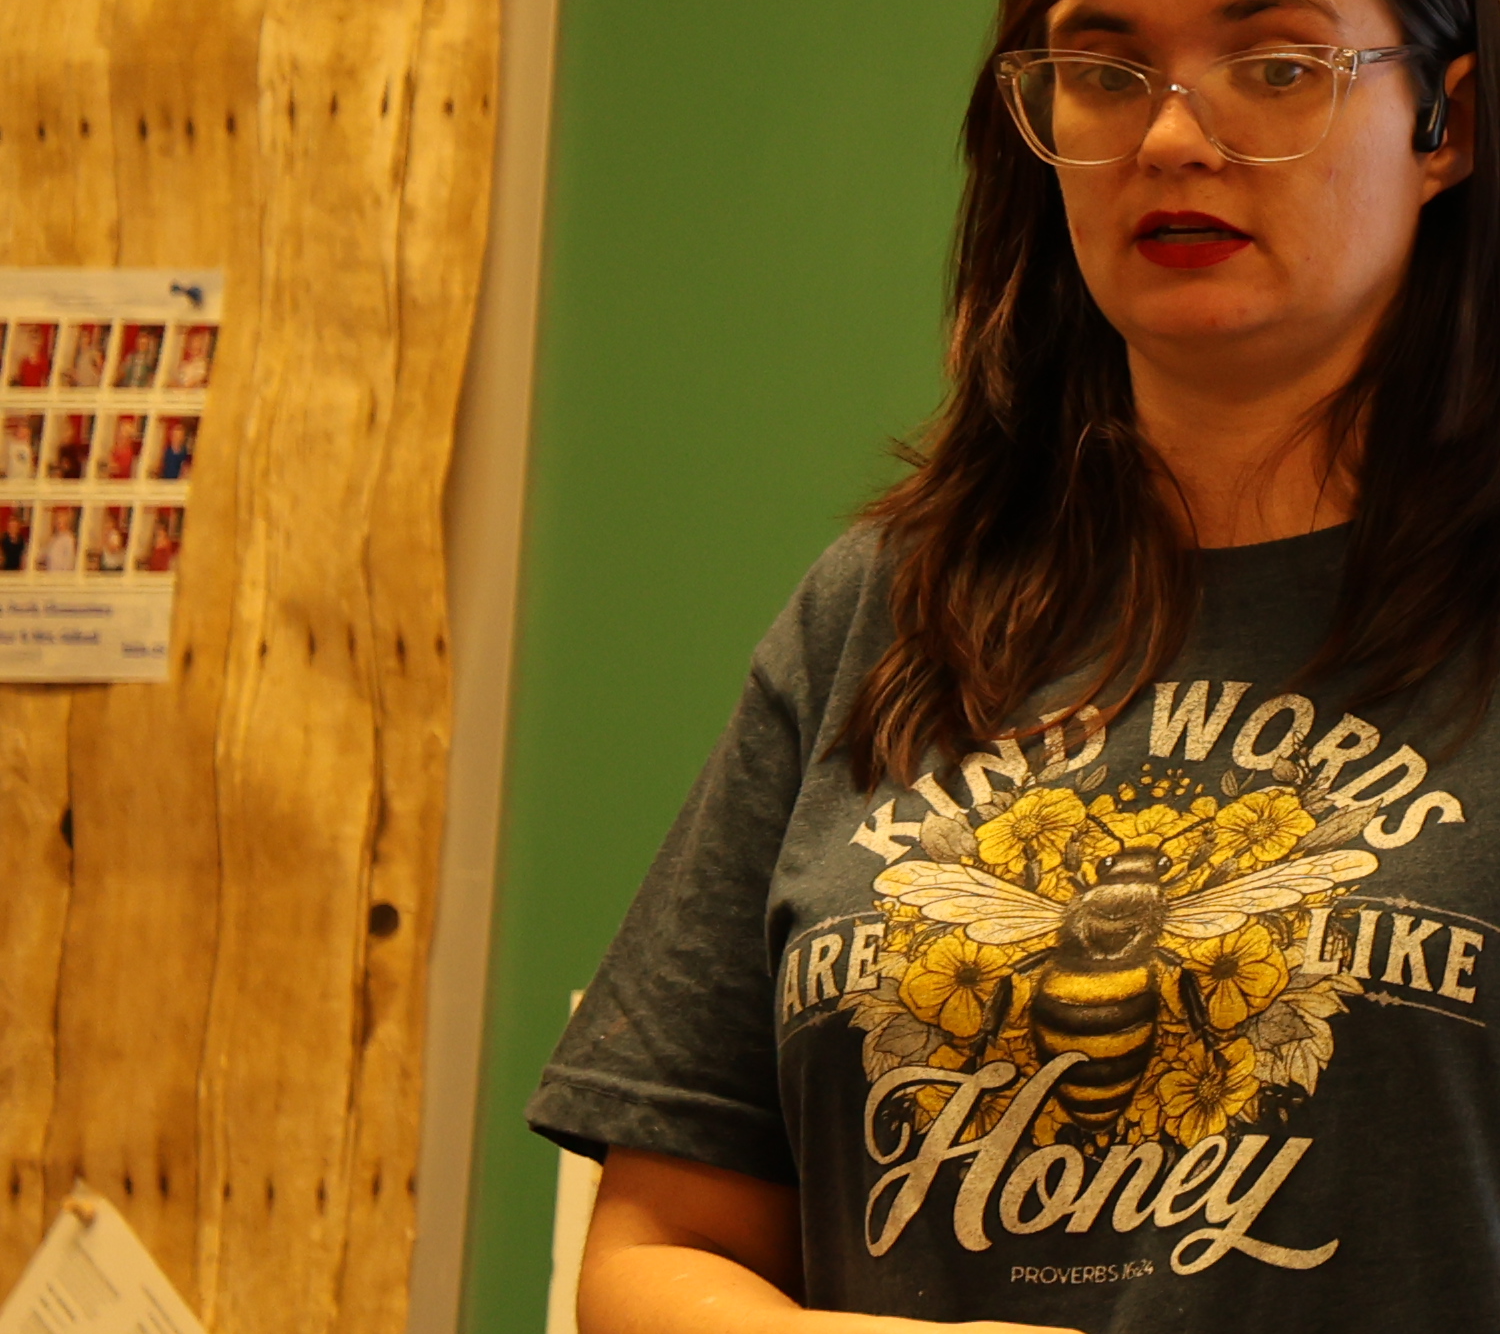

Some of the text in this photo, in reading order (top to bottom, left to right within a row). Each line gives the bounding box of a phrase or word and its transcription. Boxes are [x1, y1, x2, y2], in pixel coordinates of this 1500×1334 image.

[849, 680, 1466, 864] KIND WORDS
[781, 920, 886, 1023] ARE
[1301, 907, 1484, 1002] LIKE
[863, 1052, 1339, 1276] Honey
[1011, 1265, 1118, 1284] PROVERBS
